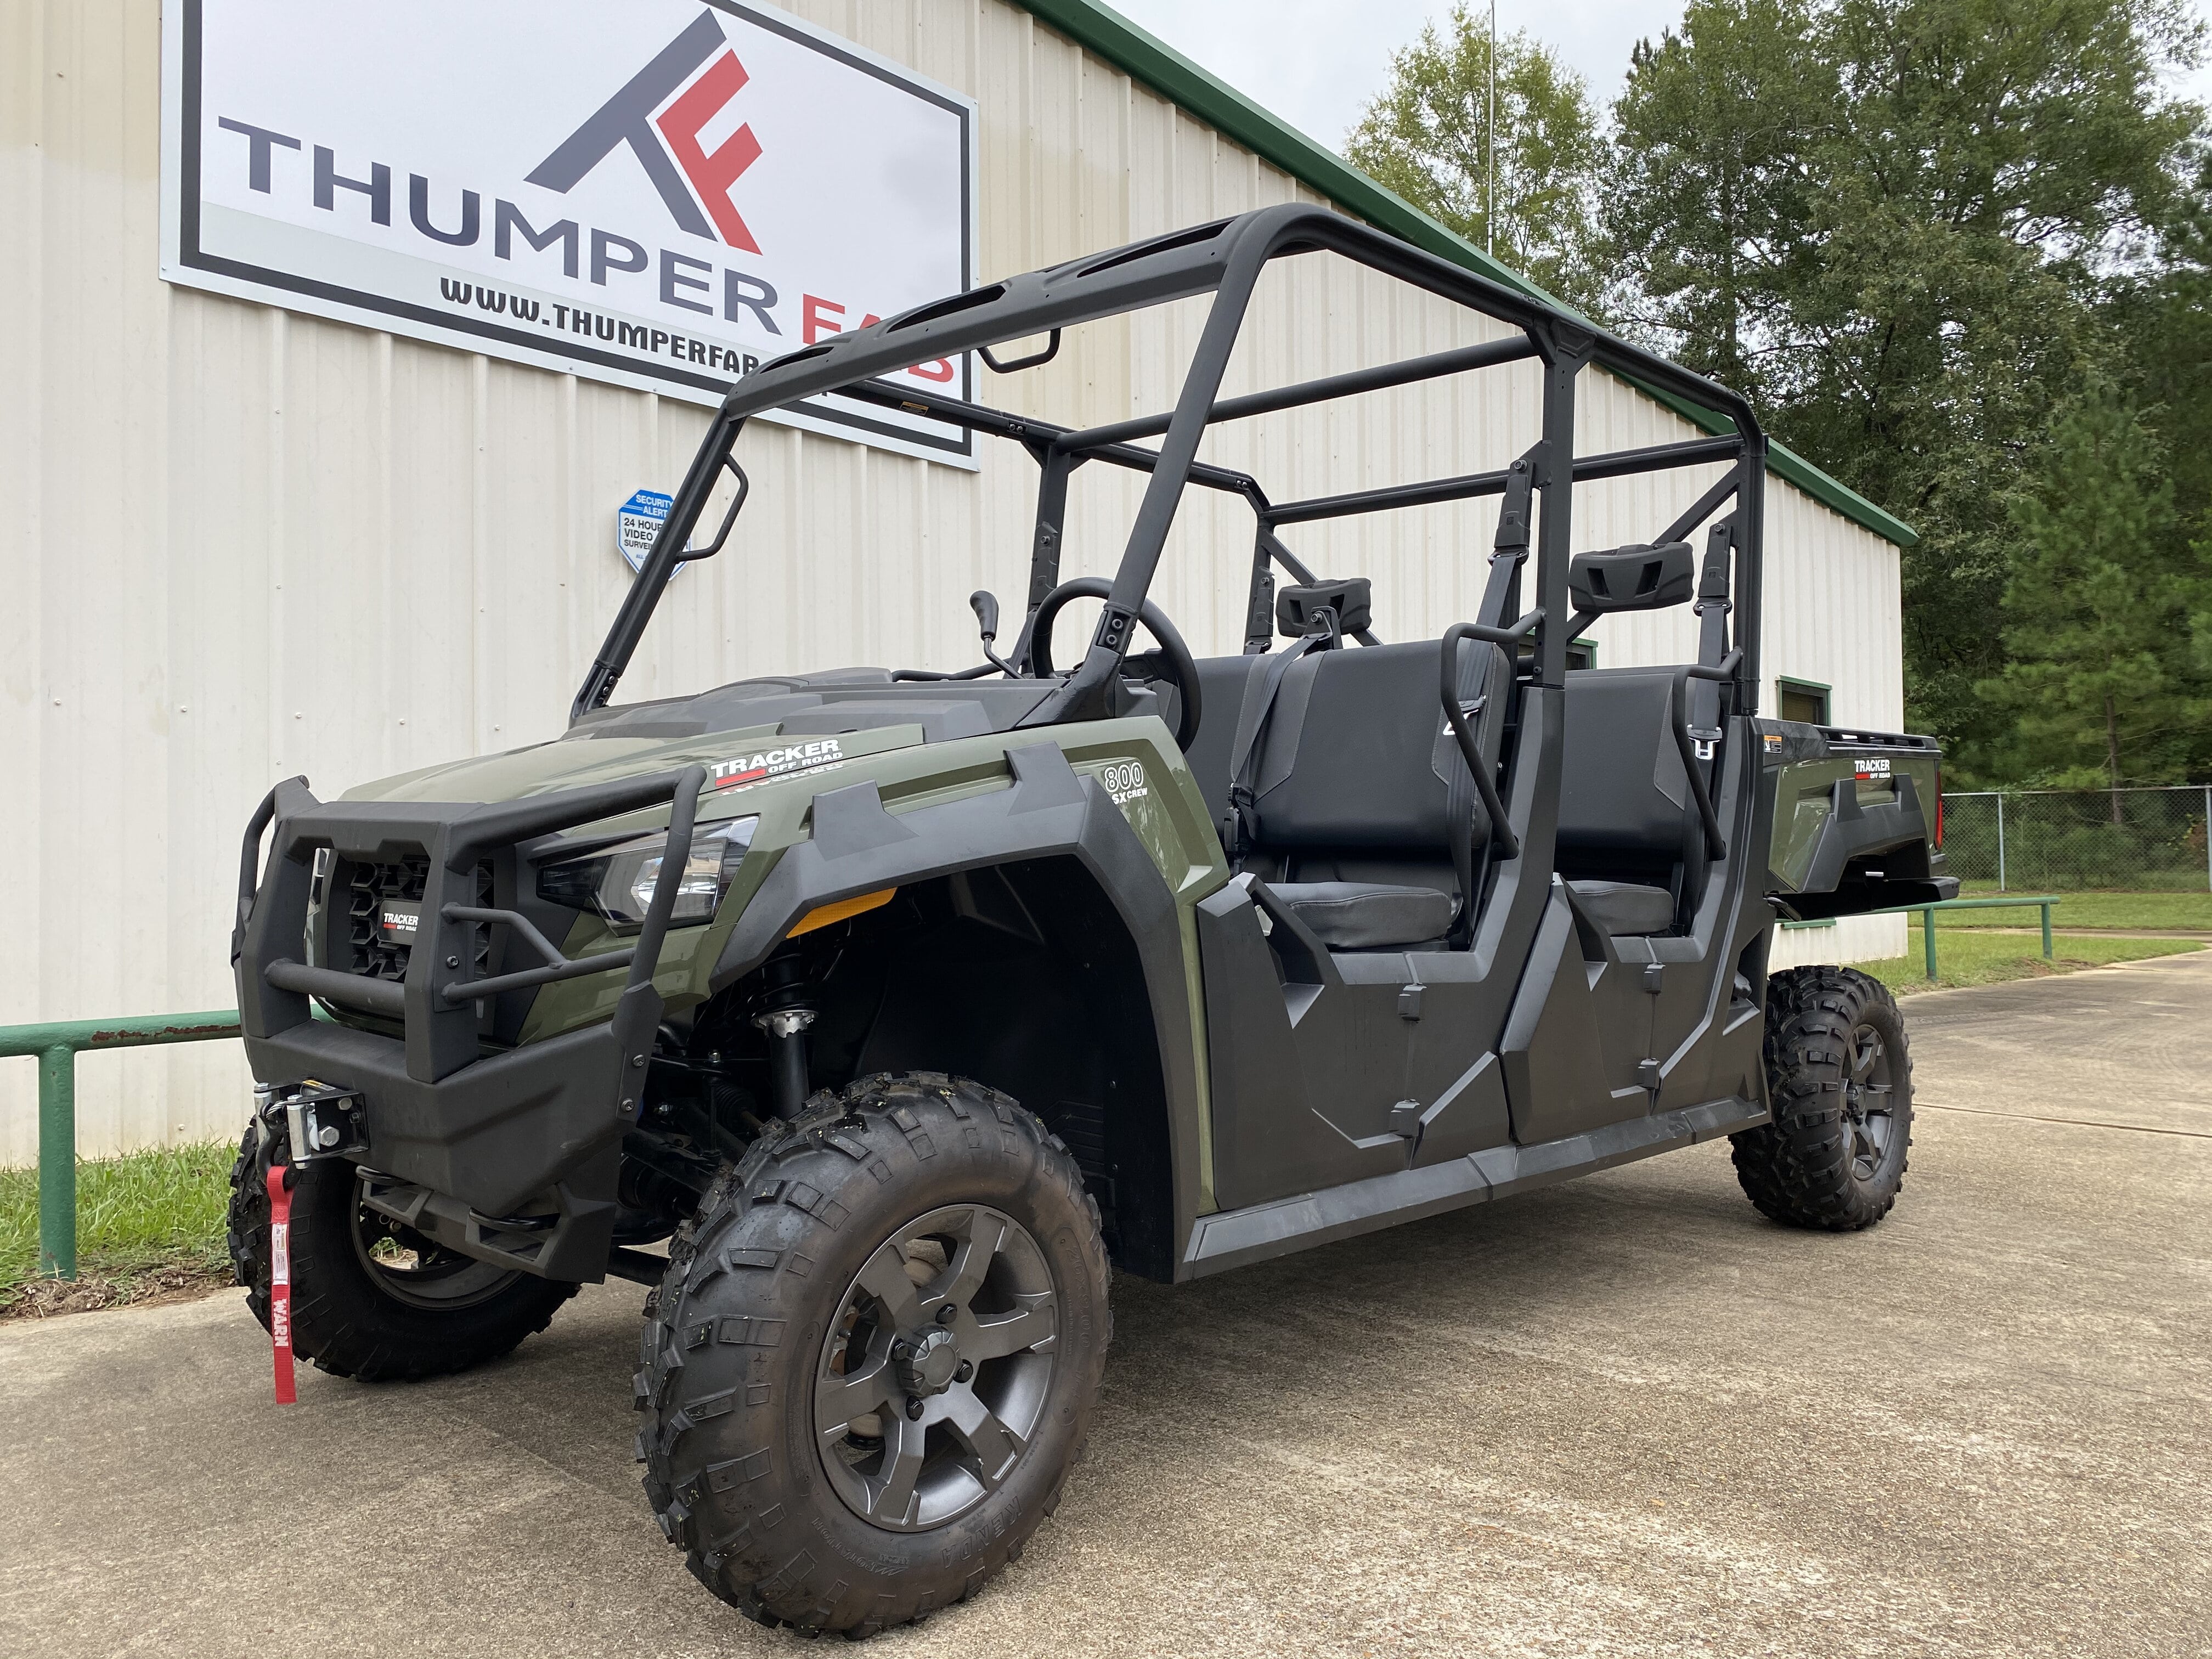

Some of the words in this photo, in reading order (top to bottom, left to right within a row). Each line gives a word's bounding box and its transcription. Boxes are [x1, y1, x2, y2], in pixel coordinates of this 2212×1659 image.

[218, 116, 782, 336] THUMPER
[441, 277, 827, 397] WWW.THUMPERFAB
[636, 494, 674, 508] SECURITY
[643, 506, 668, 518] ALERT
[624, 517, 635, 527] 24
[624, 528, 653, 541] VIDEO
[710, 739, 839, 778] TRACKER
[768, 761, 797, 774] OFF
[802, 752, 843, 766] ROAD
[1854, 759, 1890, 772] TRACKER
[1104, 762, 1144, 793] 800
[384, 912, 419, 926] TRACKER
[273, 1298, 289, 1347] WARN
[941, 1496, 1023, 1568] KENDA
